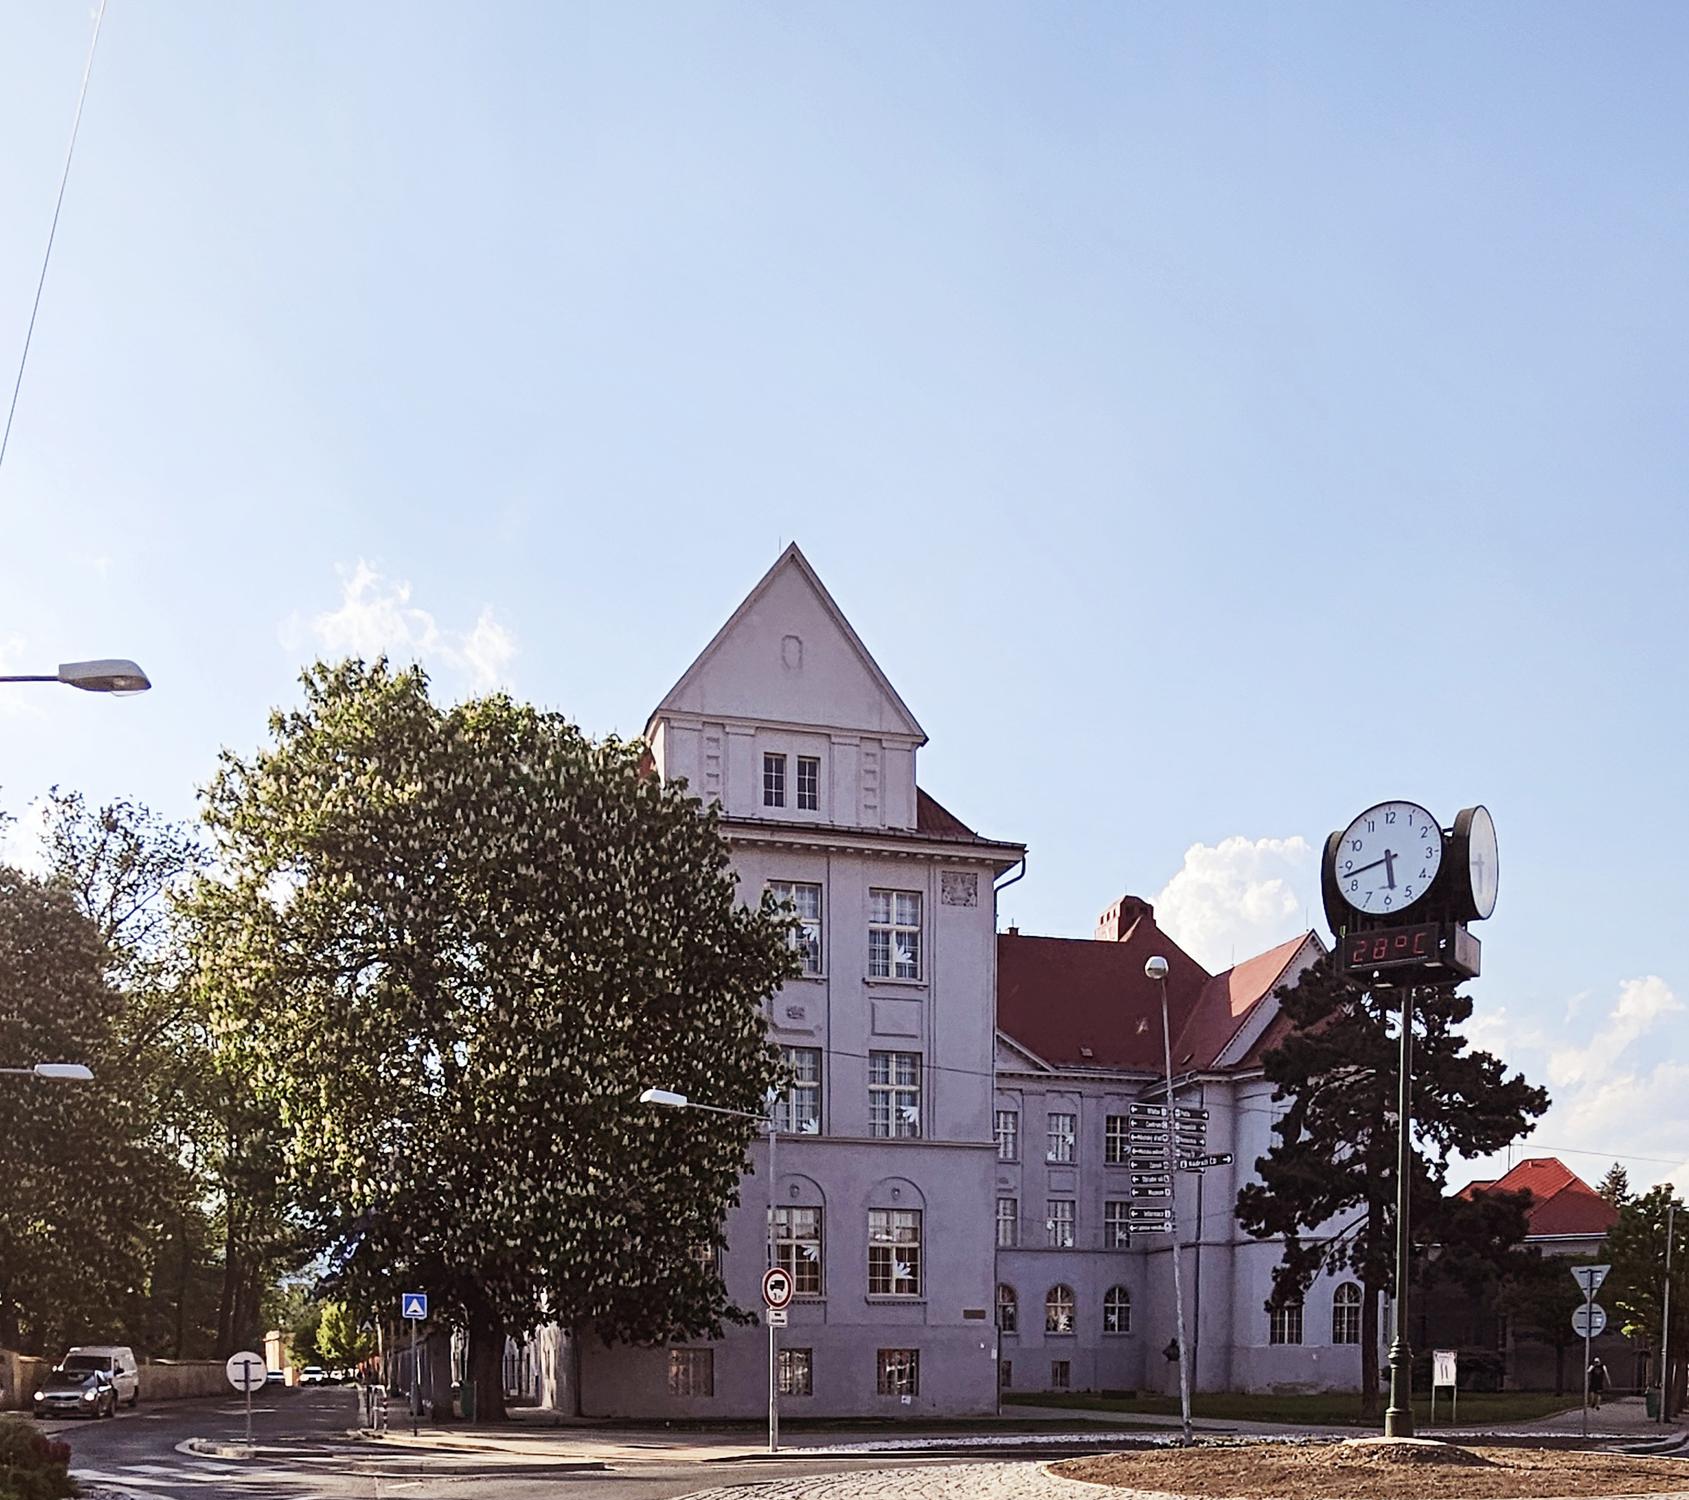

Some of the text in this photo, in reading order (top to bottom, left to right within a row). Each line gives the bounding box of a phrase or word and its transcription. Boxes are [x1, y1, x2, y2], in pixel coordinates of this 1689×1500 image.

[1385, 812, 1396, 824] 12
[1408, 814, 1413, 826] 1
[1367, 821, 1375, 833] 11
[1420, 826, 1428, 839] 2
[1351, 839, 1362, 852] 10
[1425, 847, 1433, 859] 3
[1345, 860, 1353, 871] 9
[1418, 868, 1427, 878] 4
[1350, 880, 1359, 891] 8
[1404, 885, 1412, 898] 5
[1365, 892, 1373, 903] 7
[1384, 896, 1392, 905] 6
